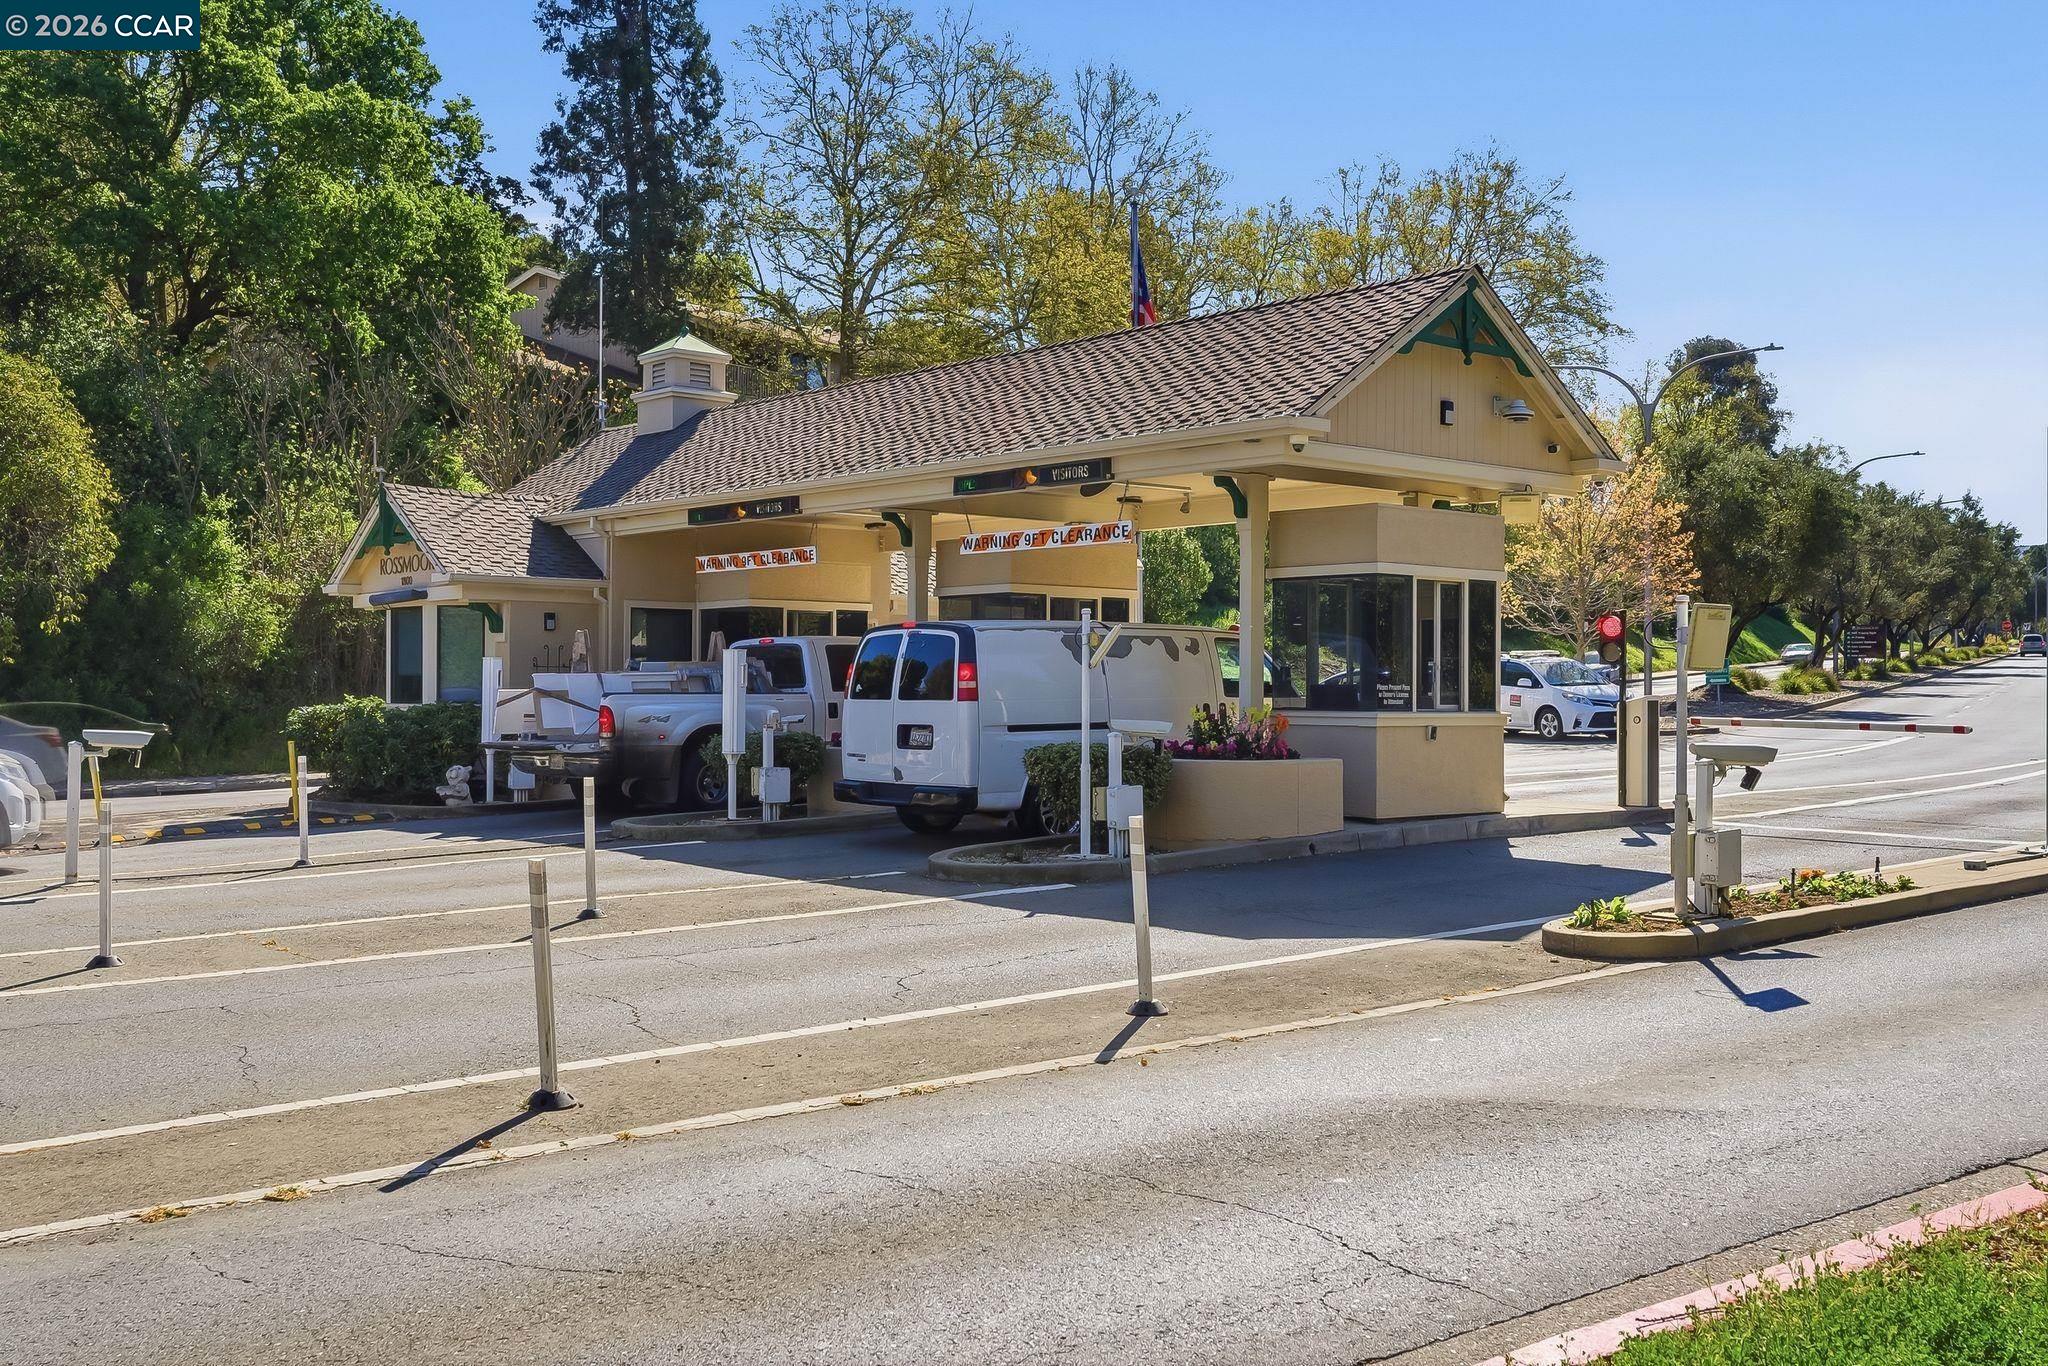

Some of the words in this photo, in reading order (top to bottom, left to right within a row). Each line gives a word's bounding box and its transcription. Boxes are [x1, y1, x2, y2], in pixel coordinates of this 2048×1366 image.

[1052, 465, 1089, 481] VISITORS
[963, 534, 1020, 551] WARNING
[1024, 531, 1047, 546] 9FT
[1051, 524, 1129, 544] CLEARANCE
[697, 556, 739, 572] WARNING
[742, 553, 758, 566] 9FT
[760, 549, 814, 565] CLEARANCE
